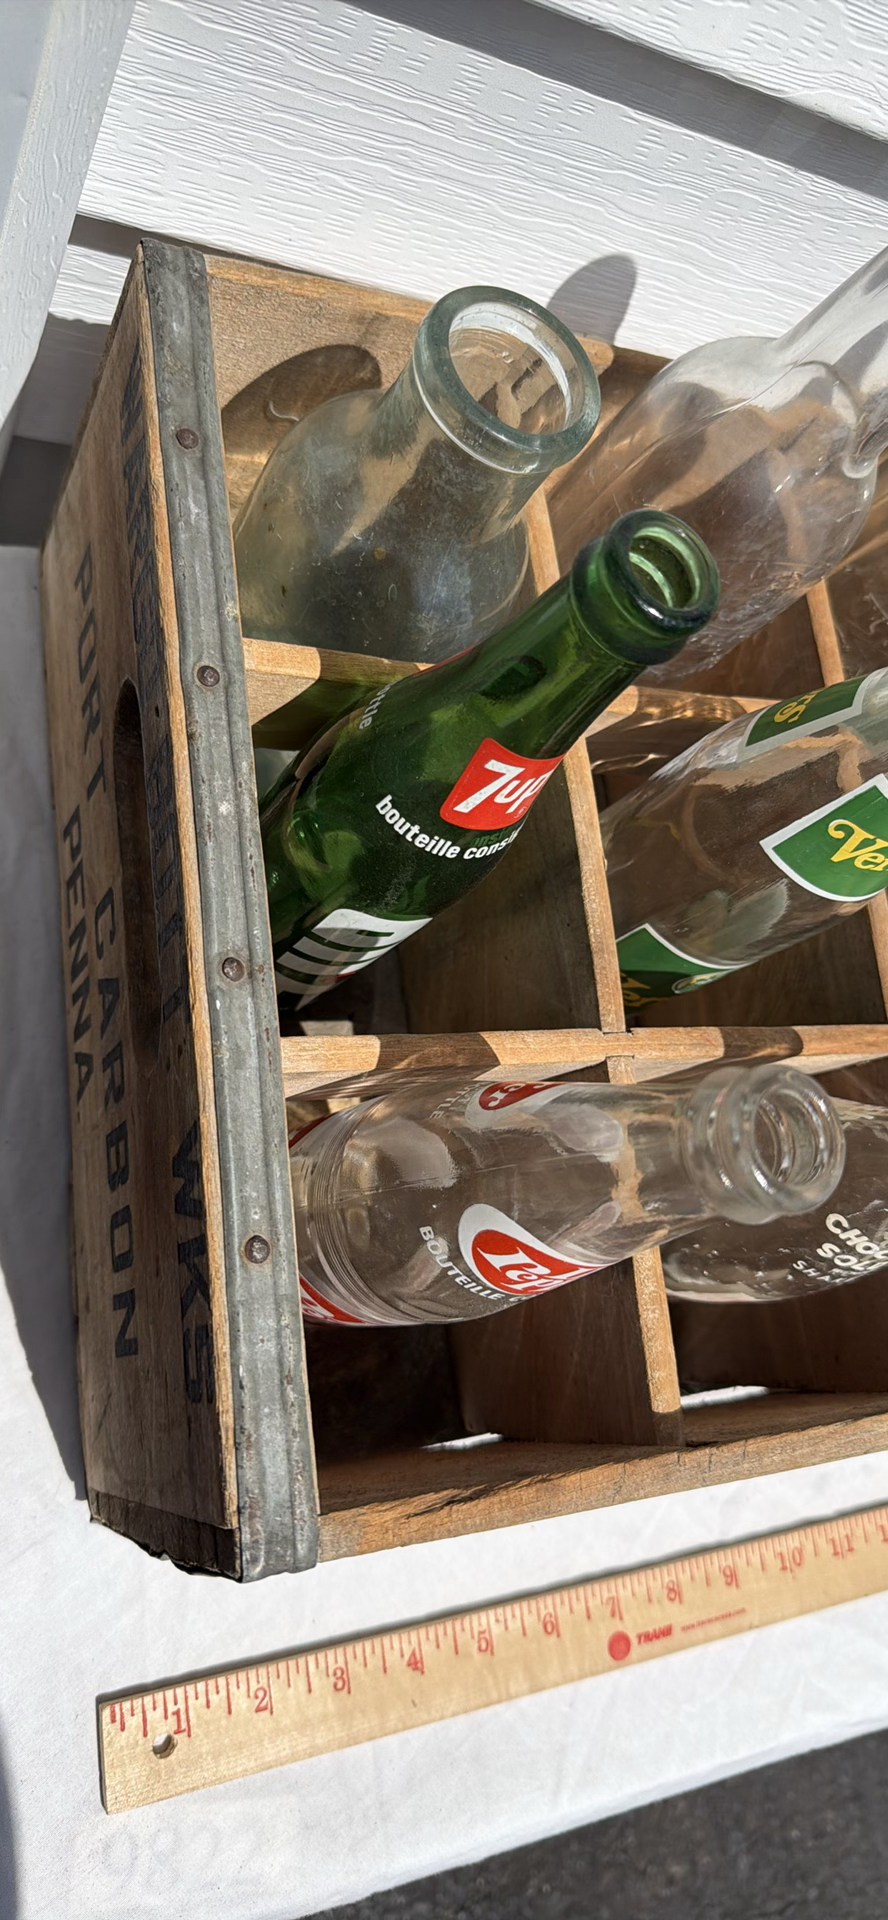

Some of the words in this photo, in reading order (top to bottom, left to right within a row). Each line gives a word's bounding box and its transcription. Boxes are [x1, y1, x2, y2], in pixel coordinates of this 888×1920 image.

[375, 794, 461, 860] bouteille
[62, 804, 94, 1123] PENNA.
[74, 543, 107, 801] PORT
[94, 885, 139, 1359] CARBON
[172, 1121, 215, 1403] WKS
[419, 1225, 506, 1301] BOUTEILLE
[171, 1708, 187, 1735] 1
[254, 1686, 269, 1713] 2
[333, 1666, 346, 1692] 3
[406, 1648, 421, 1672] 4
[477, 1630, 489, 1653] 5
[543, 1612, 555, 1635] 6
[605, 1596, 617, 1618] 7
[666, 1580, 677, 1601] 8
[723, 1564, 734, 1586] 9
[778, 1546, 803, 1571] 10
[829, 1533, 855, 1557] 11
